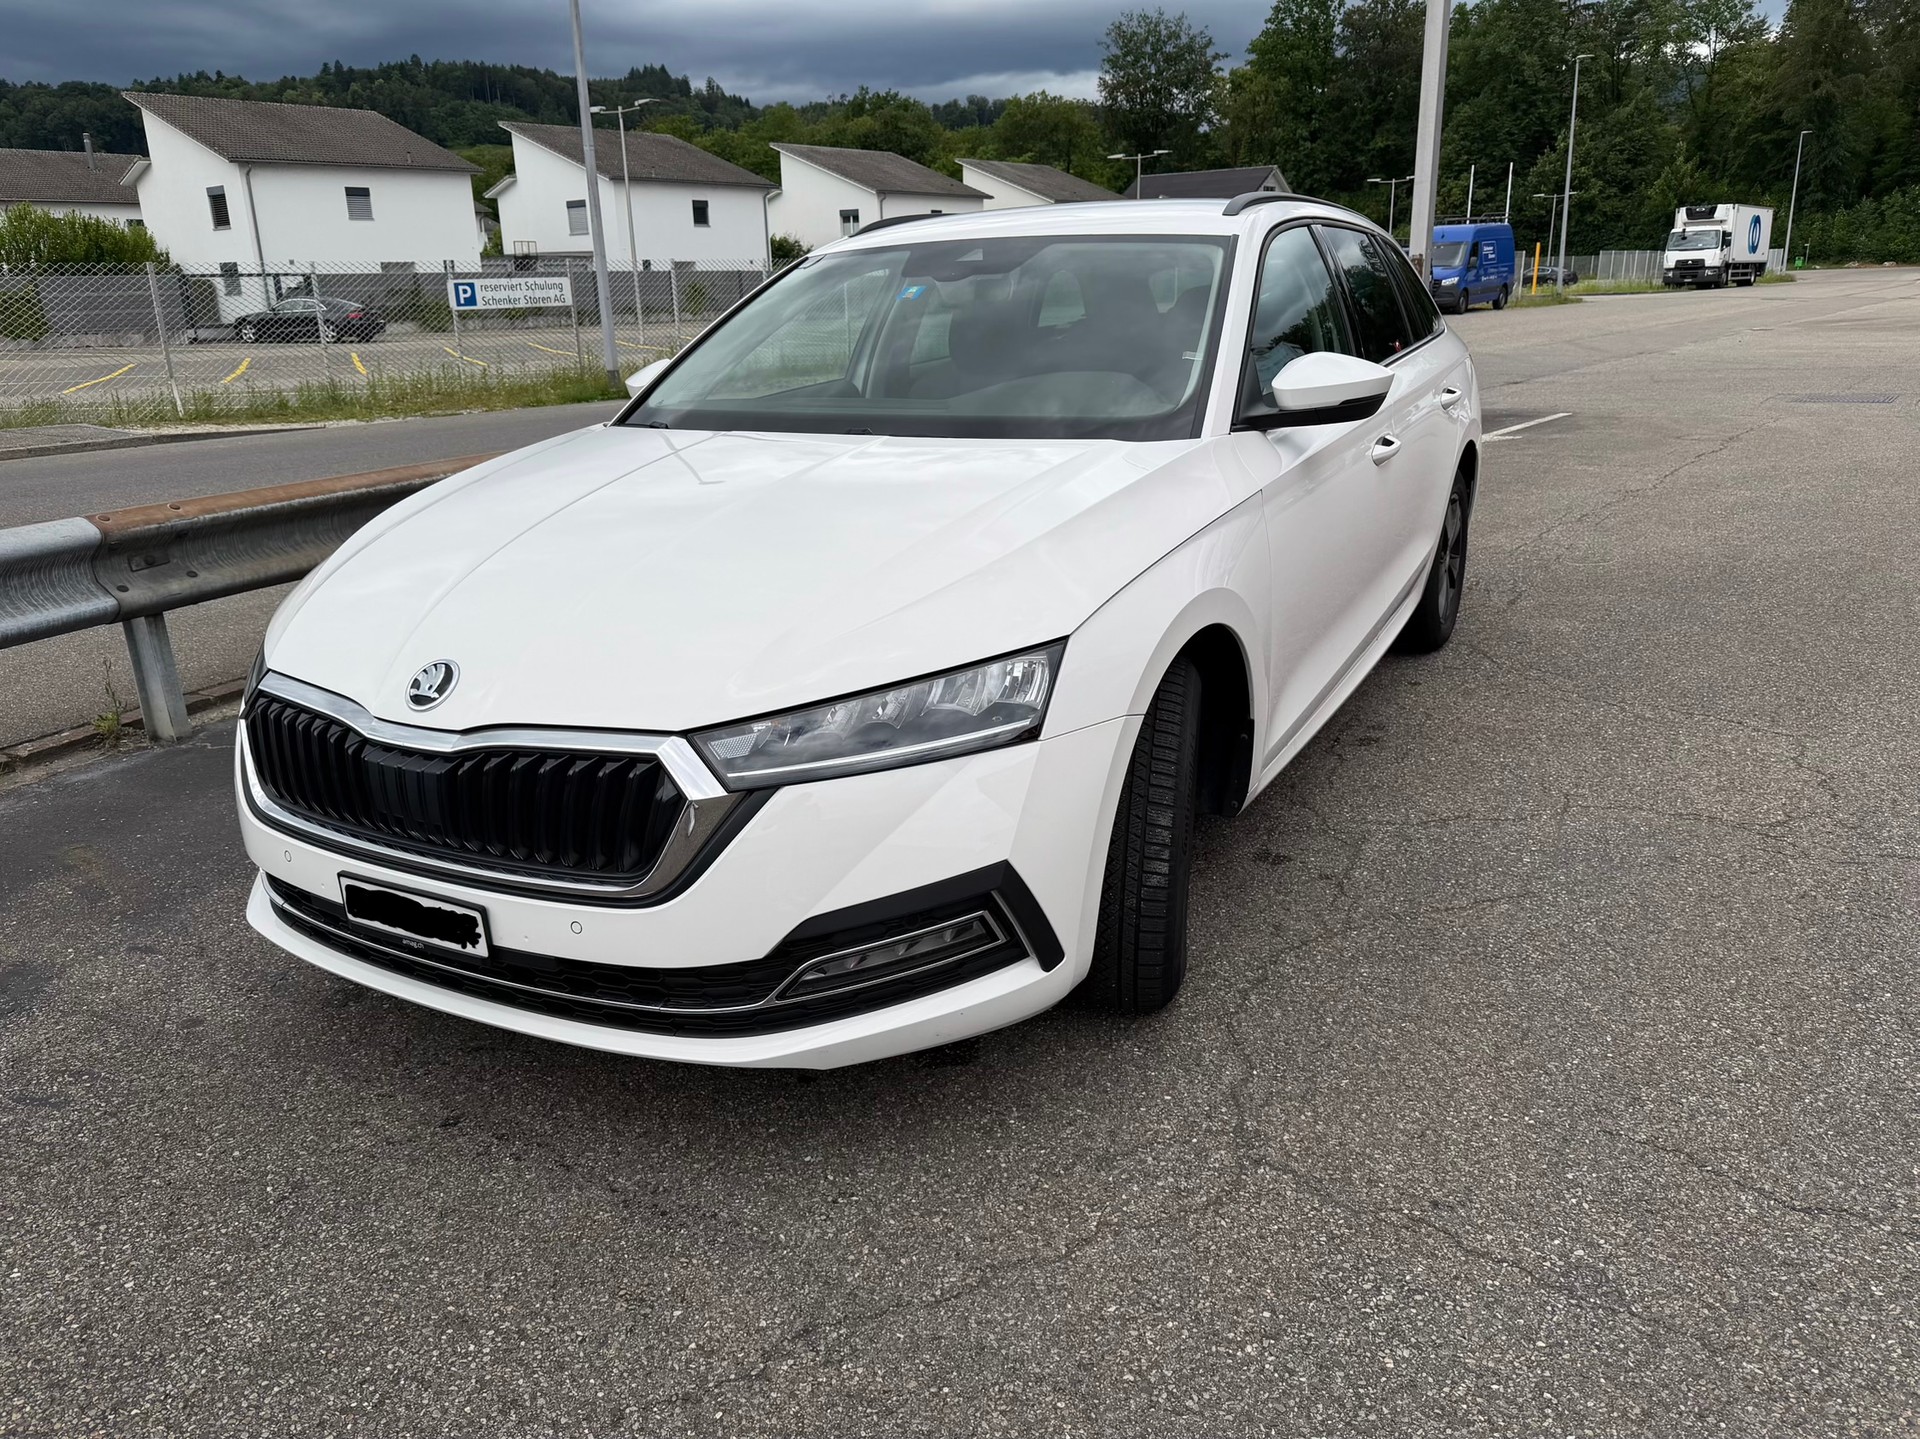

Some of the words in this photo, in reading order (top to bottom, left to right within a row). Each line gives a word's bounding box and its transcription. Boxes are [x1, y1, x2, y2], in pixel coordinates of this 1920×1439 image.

[480, 282, 522, 292] reserviert
[525, 281, 564, 292] Schulung
[458, 285, 472, 304] P
[482, 295, 521, 306] Schenker
[524, 294, 552, 305] Storen
[553, 293, 566, 304] AG
